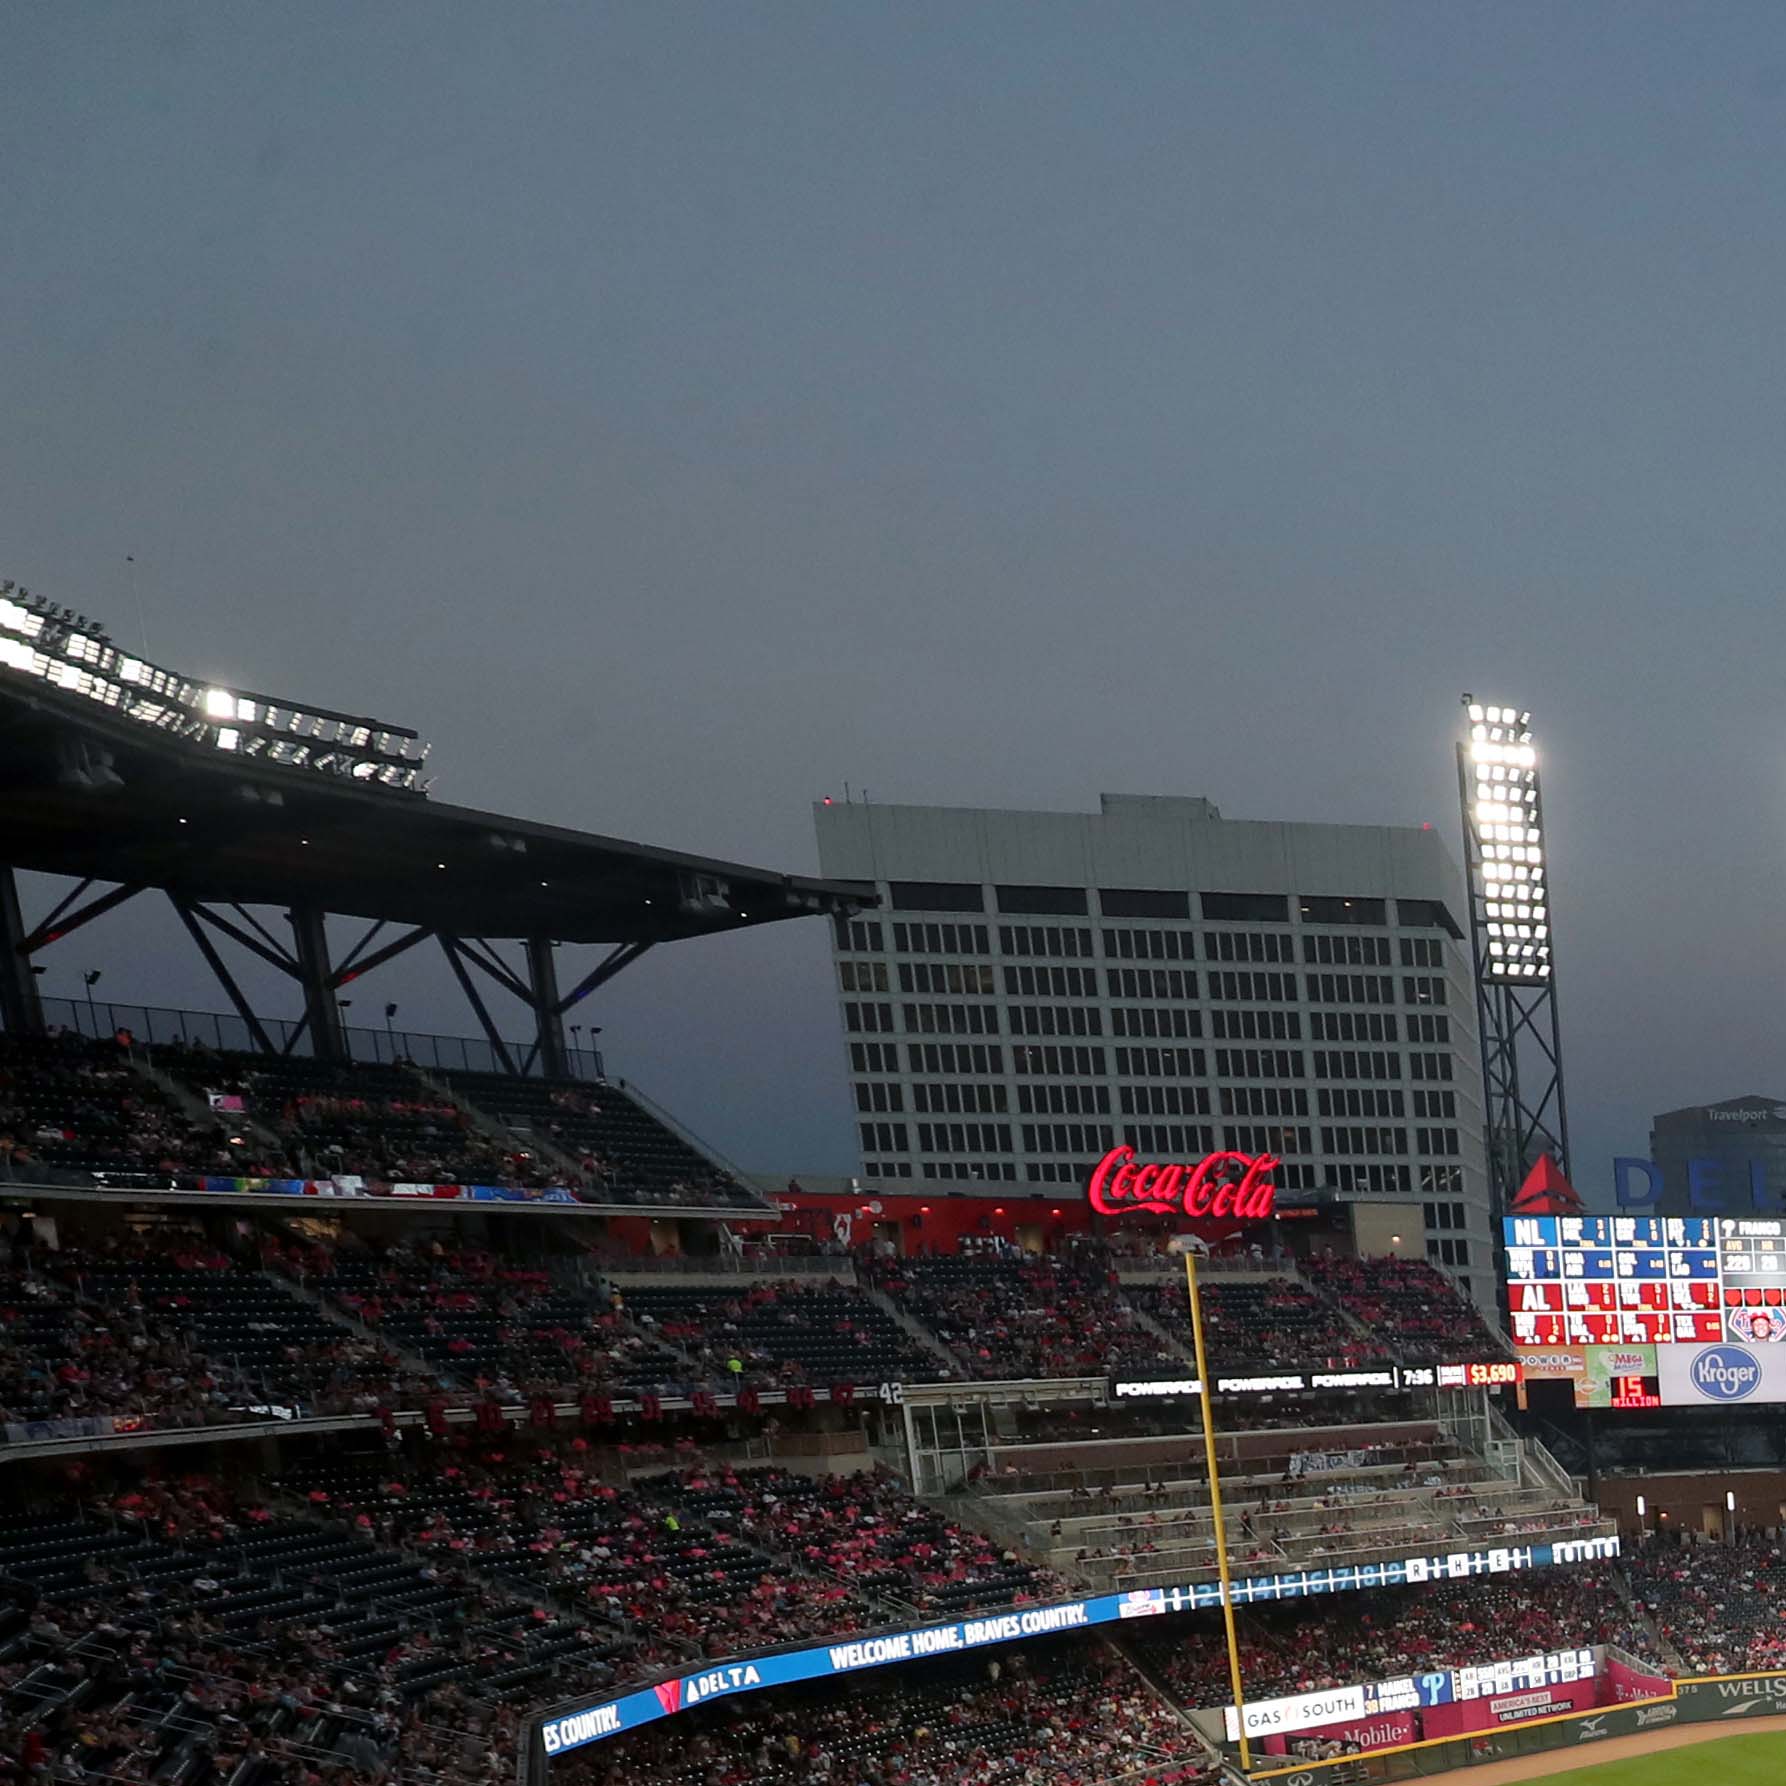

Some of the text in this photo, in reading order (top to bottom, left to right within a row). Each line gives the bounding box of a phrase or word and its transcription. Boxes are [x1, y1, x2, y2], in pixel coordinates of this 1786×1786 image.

[1088, 1144, 1281, 1218] Coca-Cola
[1514, 1219, 1545, 1245] NL
[1738, 1222, 1781, 1235] FRANCO
[1522, 1285, 1550, 1311] AL
[1403, 1369, 1434, 1386] 7:36
[1469, 1364, 1516, 1383] $3,690
[1698, 1354, 1756, 1394] Kroger
[879, 1382, 903, 1404] 42
[1618, 1377, 1642, 1397] 15
[1612, 1396, 1659, 1407] MILLION
[830, 1603, 1088, 1671] WELCOME HOME, BRAVES COUNTRY.
[699, 1666, 759, 1697] DELTA
[1378, 1678, 1417, 1697] MAIKEL
[1247, 1698, 1355, 1728] GAS SOUTH
[1379, 1692, 1420, 1712] FRANCO
[561, 1706, 620, 1746] COUNTRY.
[1345, 1724, 1403, 1748] Mobile
